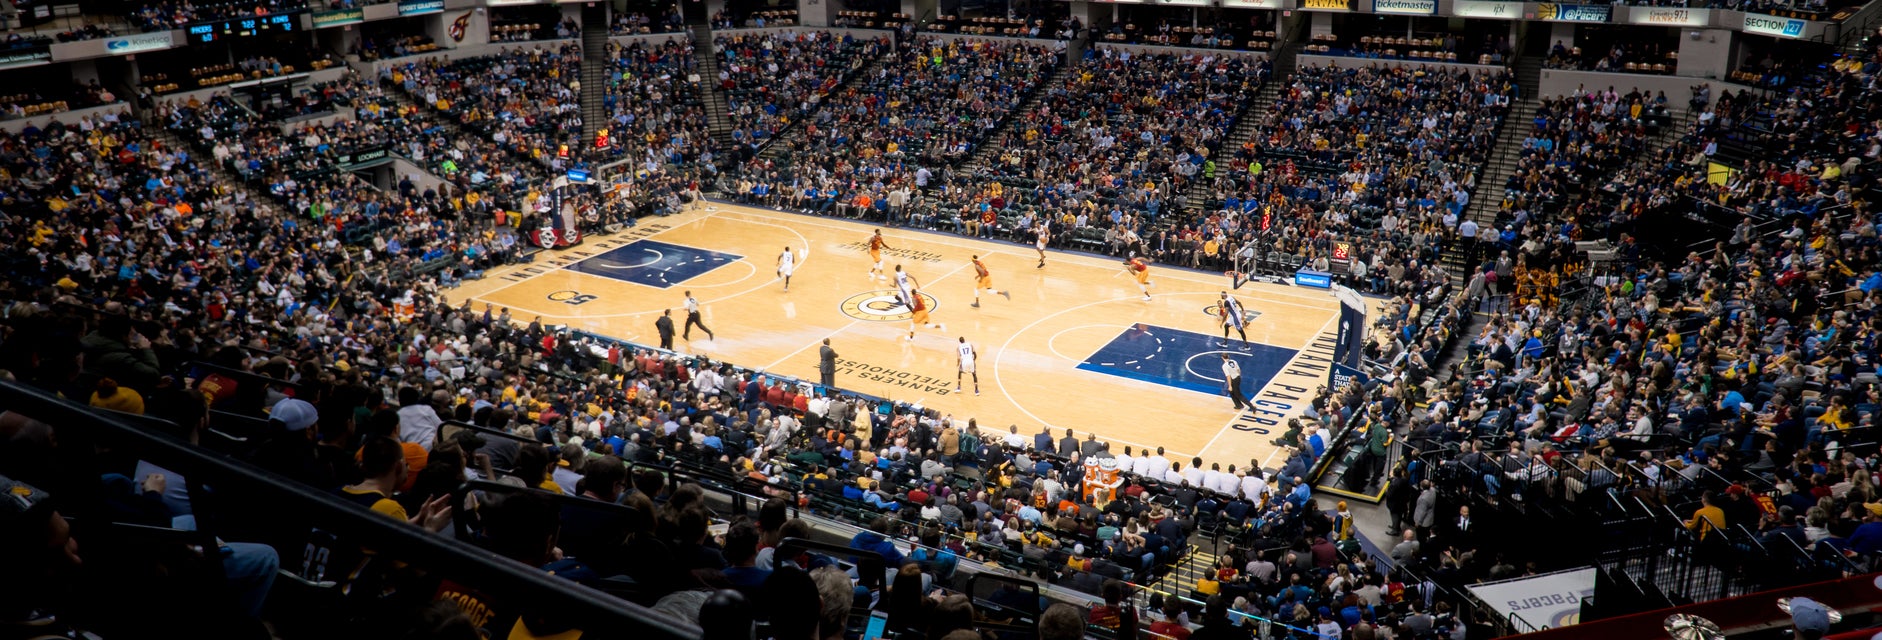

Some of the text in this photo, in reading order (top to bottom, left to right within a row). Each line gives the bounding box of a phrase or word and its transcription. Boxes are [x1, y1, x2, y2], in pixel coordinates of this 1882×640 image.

[416, 1, 444, 10] GRAPHICS
[1304, 0, 1349, 9] DEWALT
[1377, 0, 1433, 10] ticketmaster
[312, 12, 363, 23] bankerslife.com
[1564, 9, 1607, 22] @Pacers
[1674, 10, 1688, 19] 97.1
[190, 25, 213, 34] PACERS
[1745, 17, 1800, 33] SECTION 127
[132, 36, 170, 46] Kinetico
[597, 136, 608, 147] 22
[358, 150, 385, 161] LOCKHART
[500, 223, 671, 282] INDIANA PACERS
[1335, 249, 1347, 258] 22
[962, 347, 969, 355] 17
[835, 358, 952, 387] FIELDHOUSE
[857, 371, 951, 396] BANKERS
[1231, 331, 1338, 435] INDIANA PACERS
[1762, 502, 1777, 513] 13
[1507, 591, 1579, 611] Pacers
